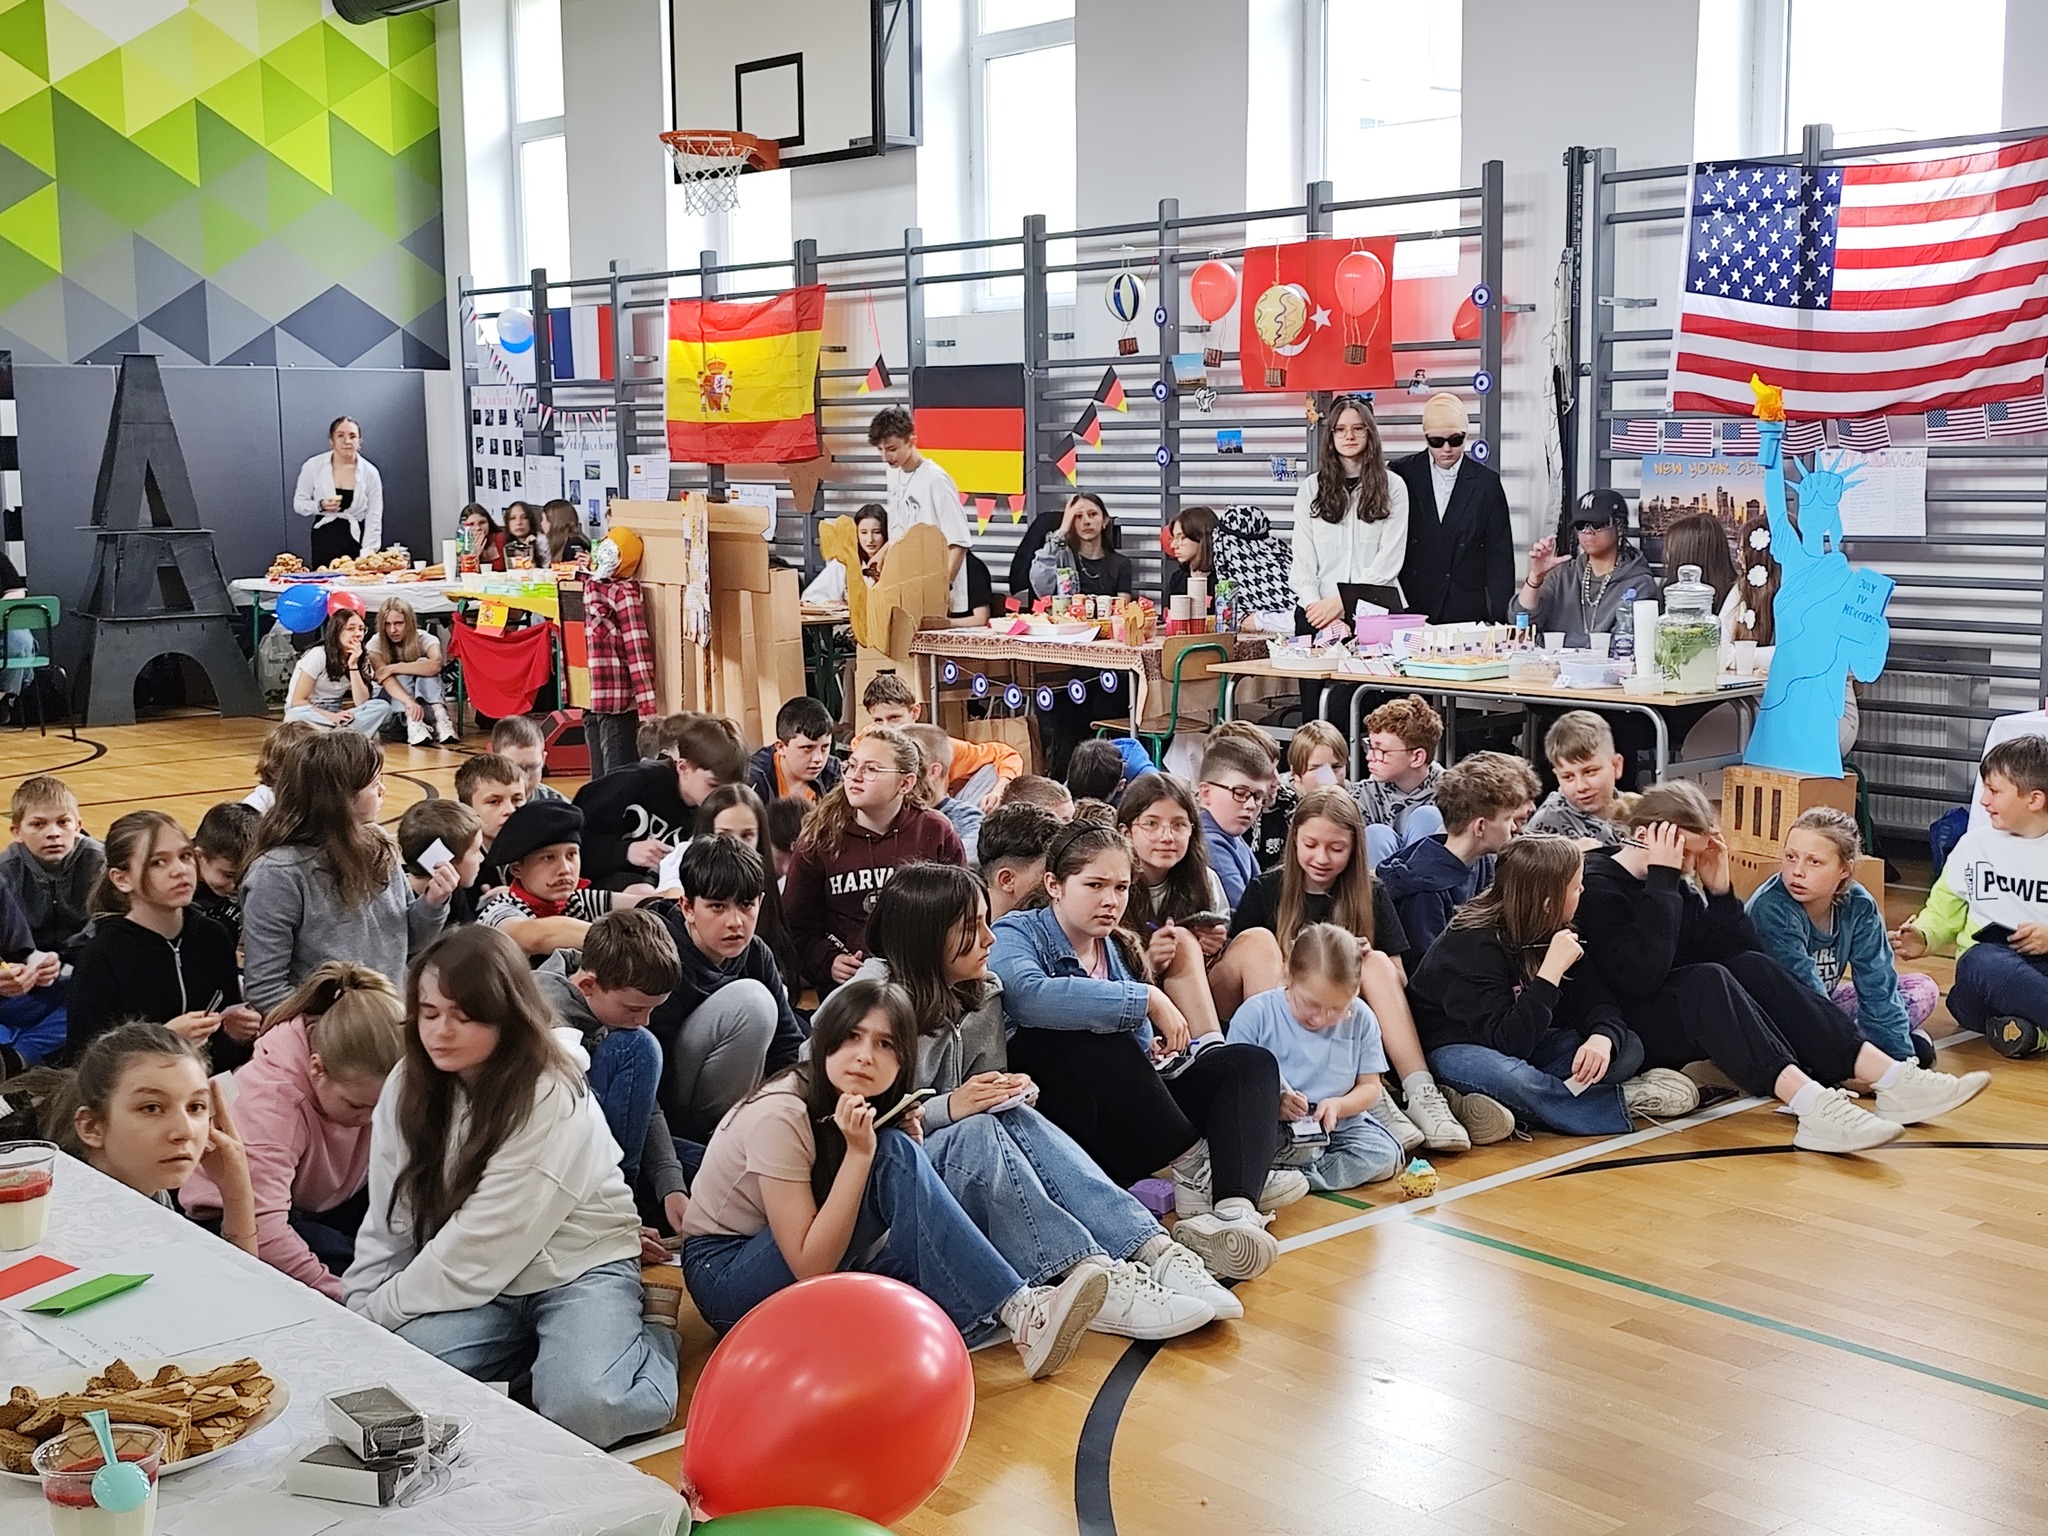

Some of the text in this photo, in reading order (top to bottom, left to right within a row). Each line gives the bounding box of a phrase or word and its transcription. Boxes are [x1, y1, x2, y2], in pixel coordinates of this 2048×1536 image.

[1653, 462, 1684, 476] NEW
[1688, 462, 1731, 479] YORK
[1858, 578, 1878, 594] JULY
[1856, 593, 1868, 605] IV
